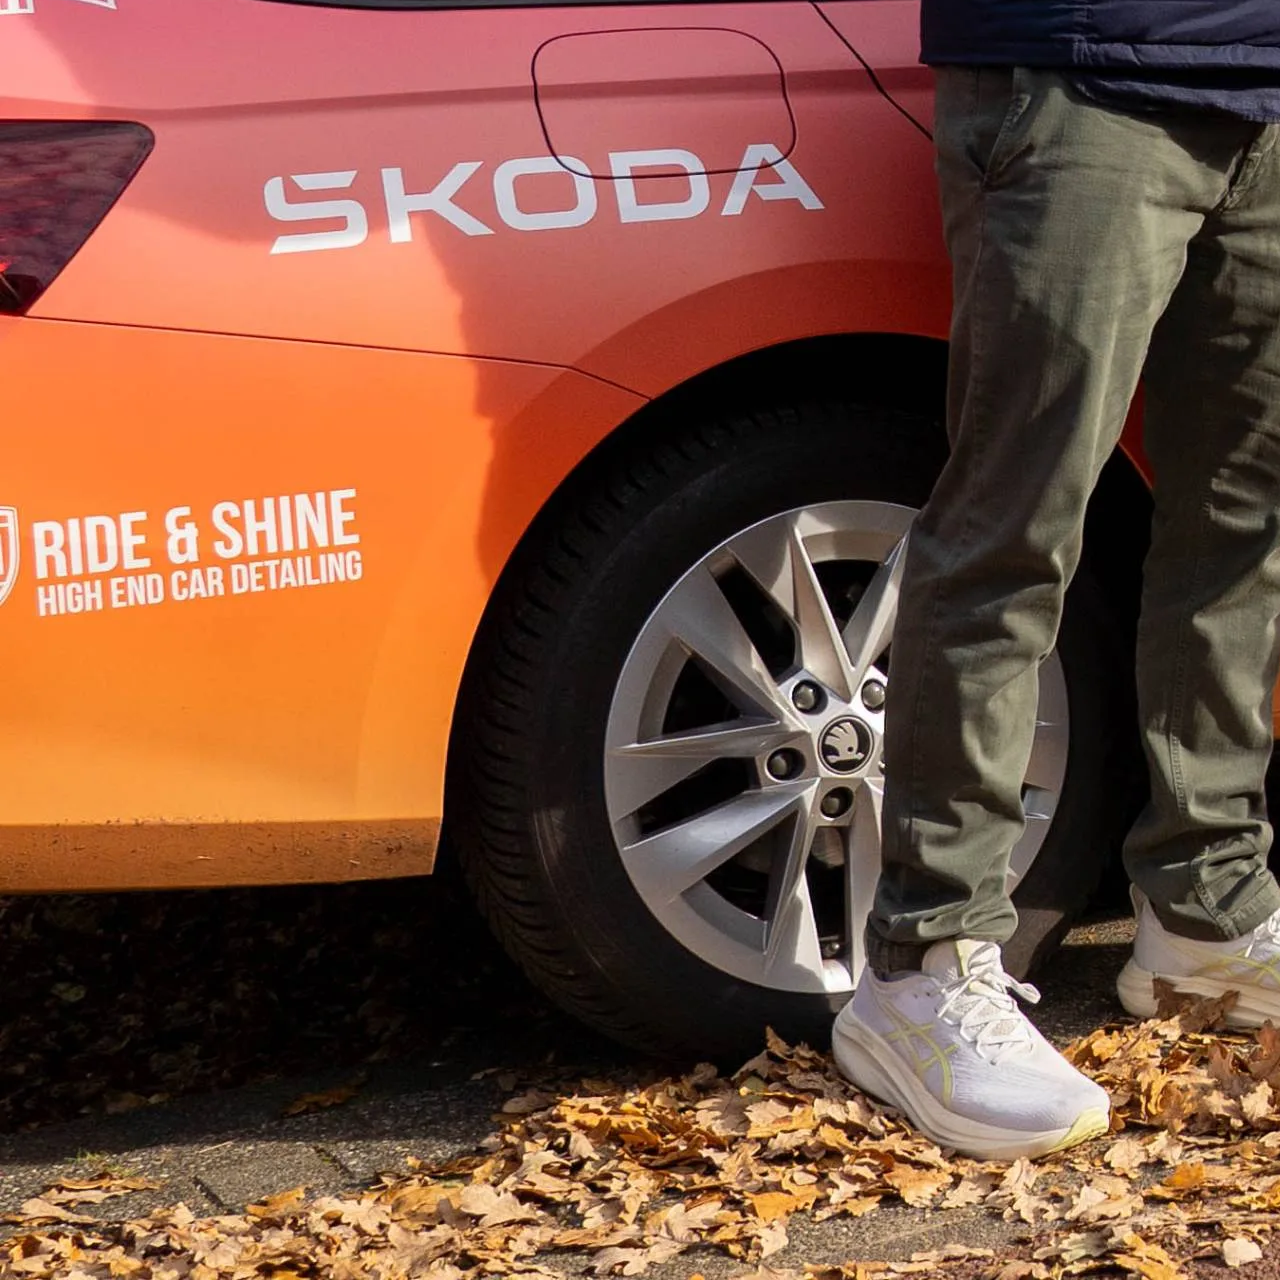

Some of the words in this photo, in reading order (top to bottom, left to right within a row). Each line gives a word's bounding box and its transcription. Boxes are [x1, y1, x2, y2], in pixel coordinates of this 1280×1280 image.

[264, 143, 824, 255] SKODA
[32, 511, 152, 580] RIDE
[165, 506, 199, 566] &
[211, 488, 361, 560] SHINE
[37, 579, 103, 617] HIGH
[110, 573, 164, 608] END
[171, 565, 225, 601] CAR
[231, 550, 363, 595] DETAILING
